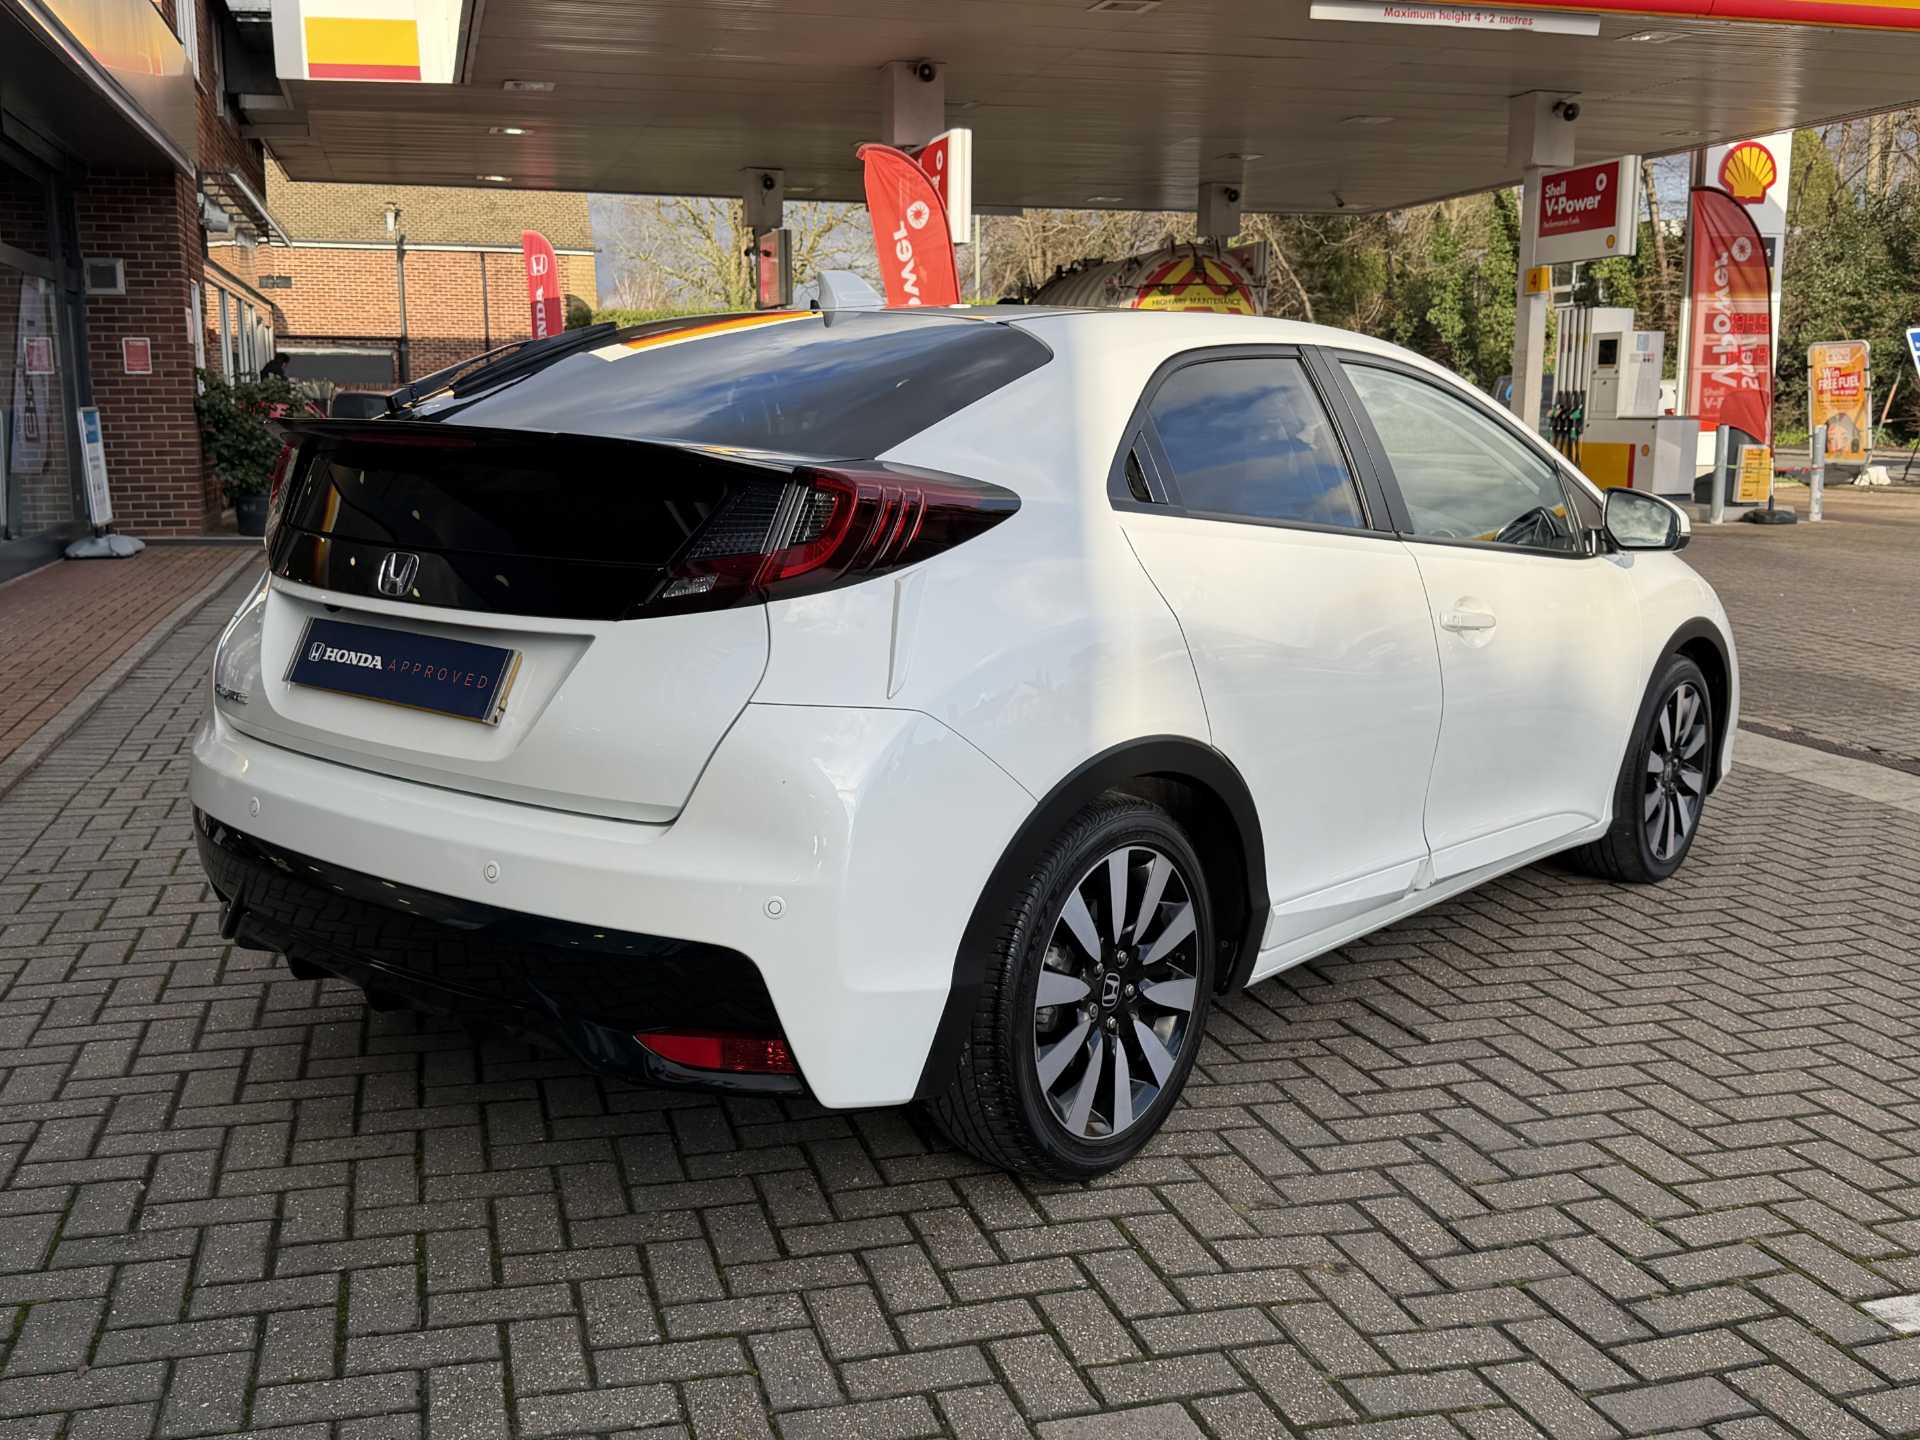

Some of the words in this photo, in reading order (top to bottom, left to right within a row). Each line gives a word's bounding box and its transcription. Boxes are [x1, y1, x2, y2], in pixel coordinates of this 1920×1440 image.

[1384, 7, 1436, 20] Maximum
[1439, 10, 1471, 23] height
[1499, 15, 1534, 26] metres
[1545, 181, 1567, 198] Shell
[1545, 194, 1601, 217] V-Power
[1530, 272, 1538, 289] 4
[1822, 368, 1840, 380] Win
[1818, 378, 1839, 391] FREE
[1839, 375, 1860, 389] FUEL
[322, 647, 383, 670] HONDA
[387, 659, 489, 689] APPROVED
